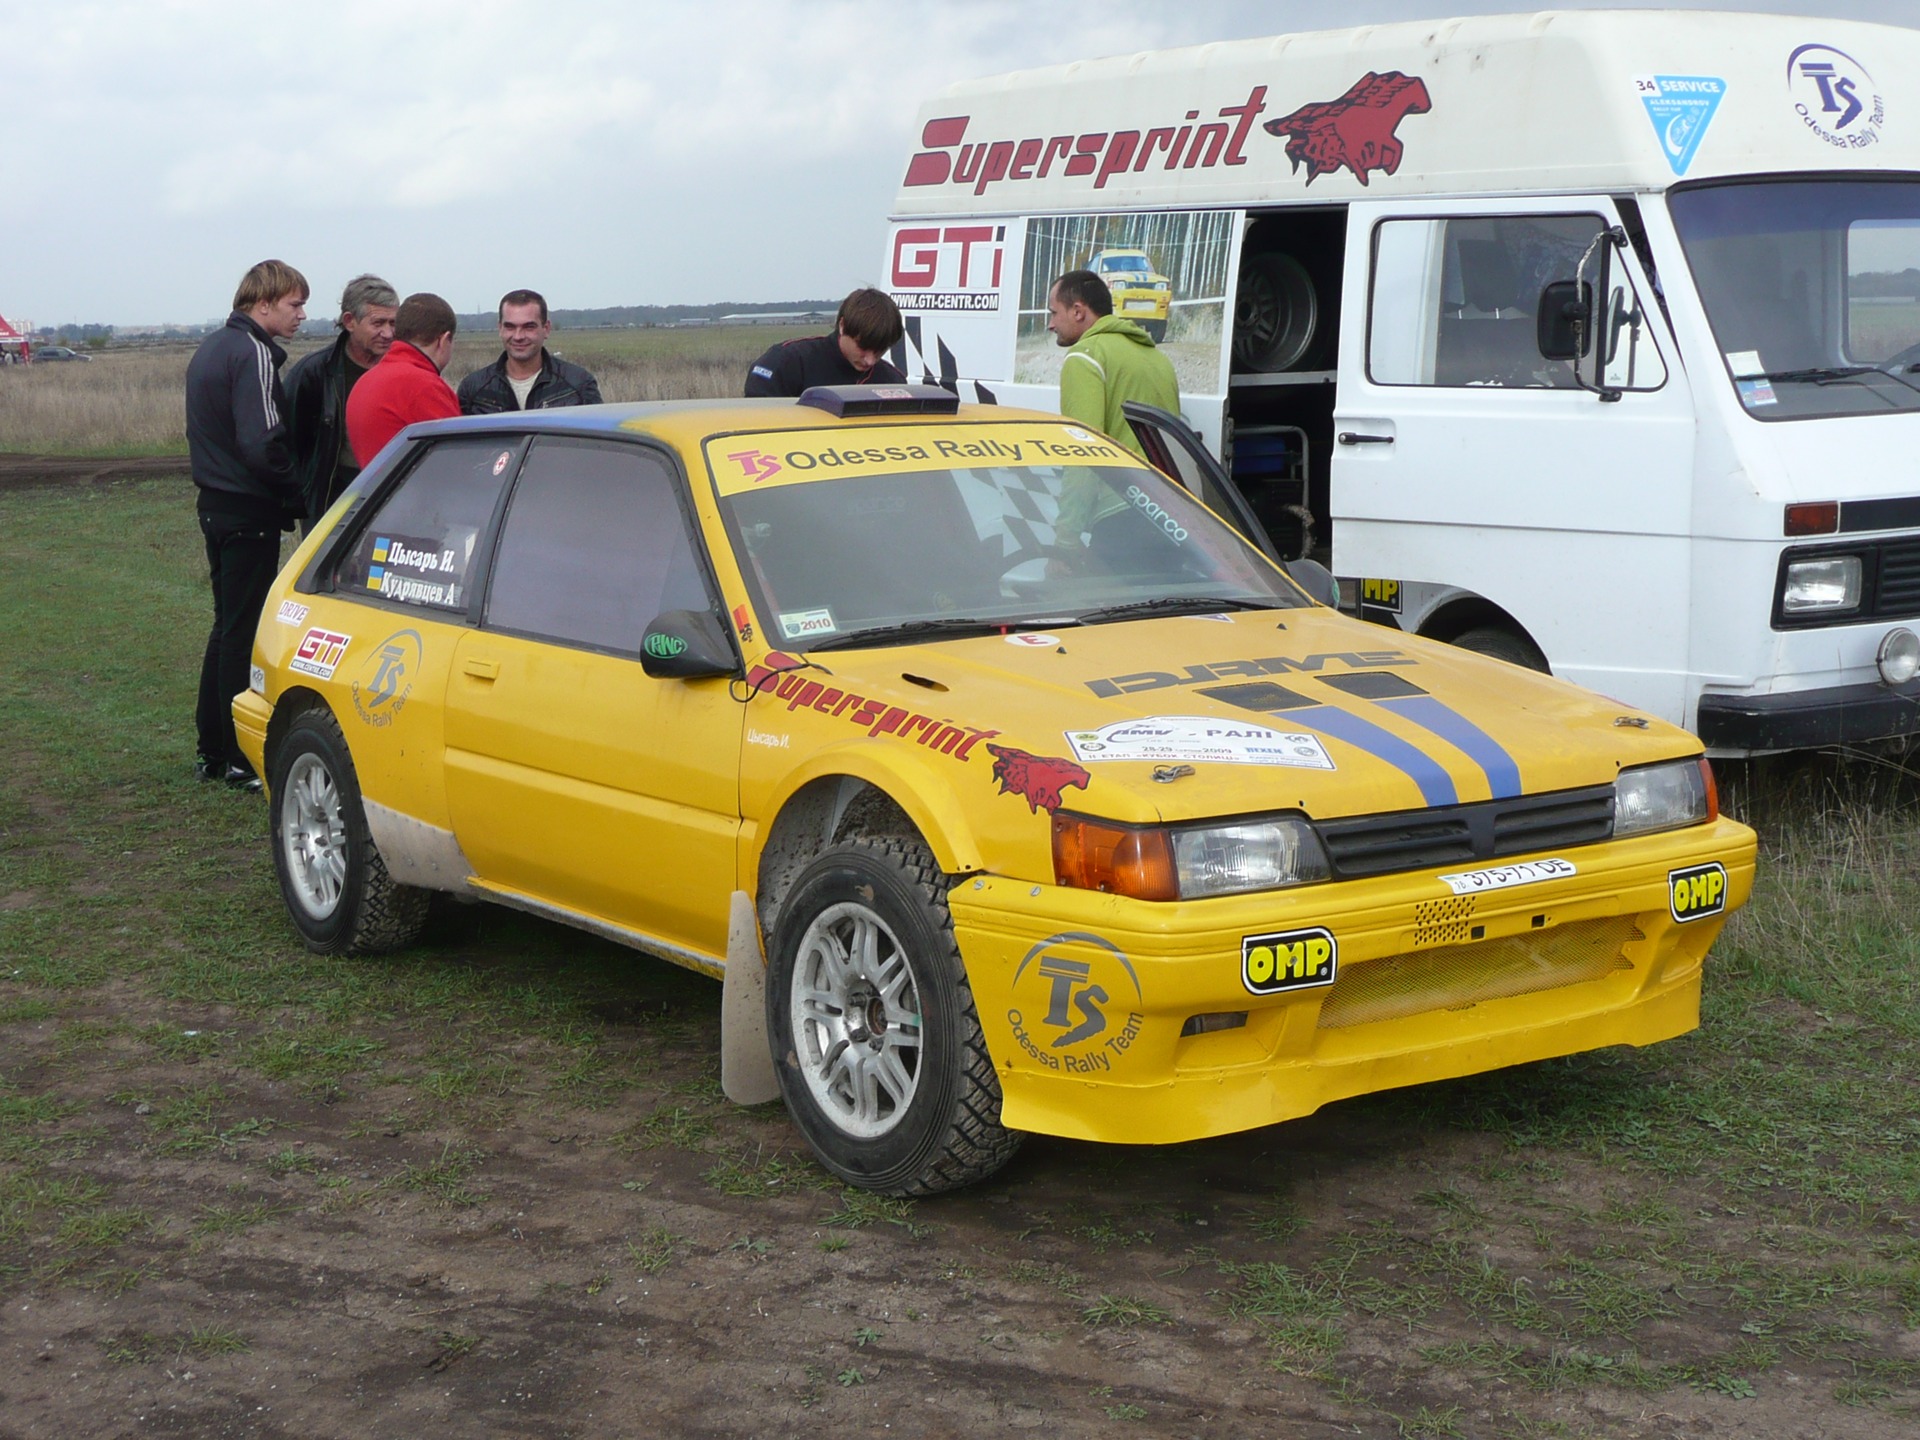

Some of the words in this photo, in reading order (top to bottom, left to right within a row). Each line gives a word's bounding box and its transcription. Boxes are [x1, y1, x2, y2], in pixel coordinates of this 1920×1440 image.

[1660, 80, 1721, 93] SERVICE
[1794, 102, 1848, 149] Odessa
[1846, 127, 1880, 149] Rally
[1867, 94, 1885, 130] Team
[904, 85, 1268, 196] Supersprint
[890, 294, 999, 310] WWW.GTI-CENTR.COM
[785, 445, 929, 471] Odessa
[932, 439, 1023, 462] Rally
[1025, 439, 1119, 459] Team
[1126, 485, 1188, 542] sparco
[388, 541, 438, 572] Цысарь
[380, 571, 443, 604] Кудрявцев
[1364, 577, 1399, 603] MP
[279, 601, 309, 621] DRIVE
[800, 618, 831, 631] 2010
[372, 711, 393, 728] Rally
[391, 683, 413, 716] Team
[746, 650, 1001, 762] Supersprint
[747, 728, 779, 748] Цысарь
[1007, 1008, 1061, 1071] Odessa
[1063, 1051, 1112, 1074] Rally
[1104, 1011, 1145, 1056] Team
